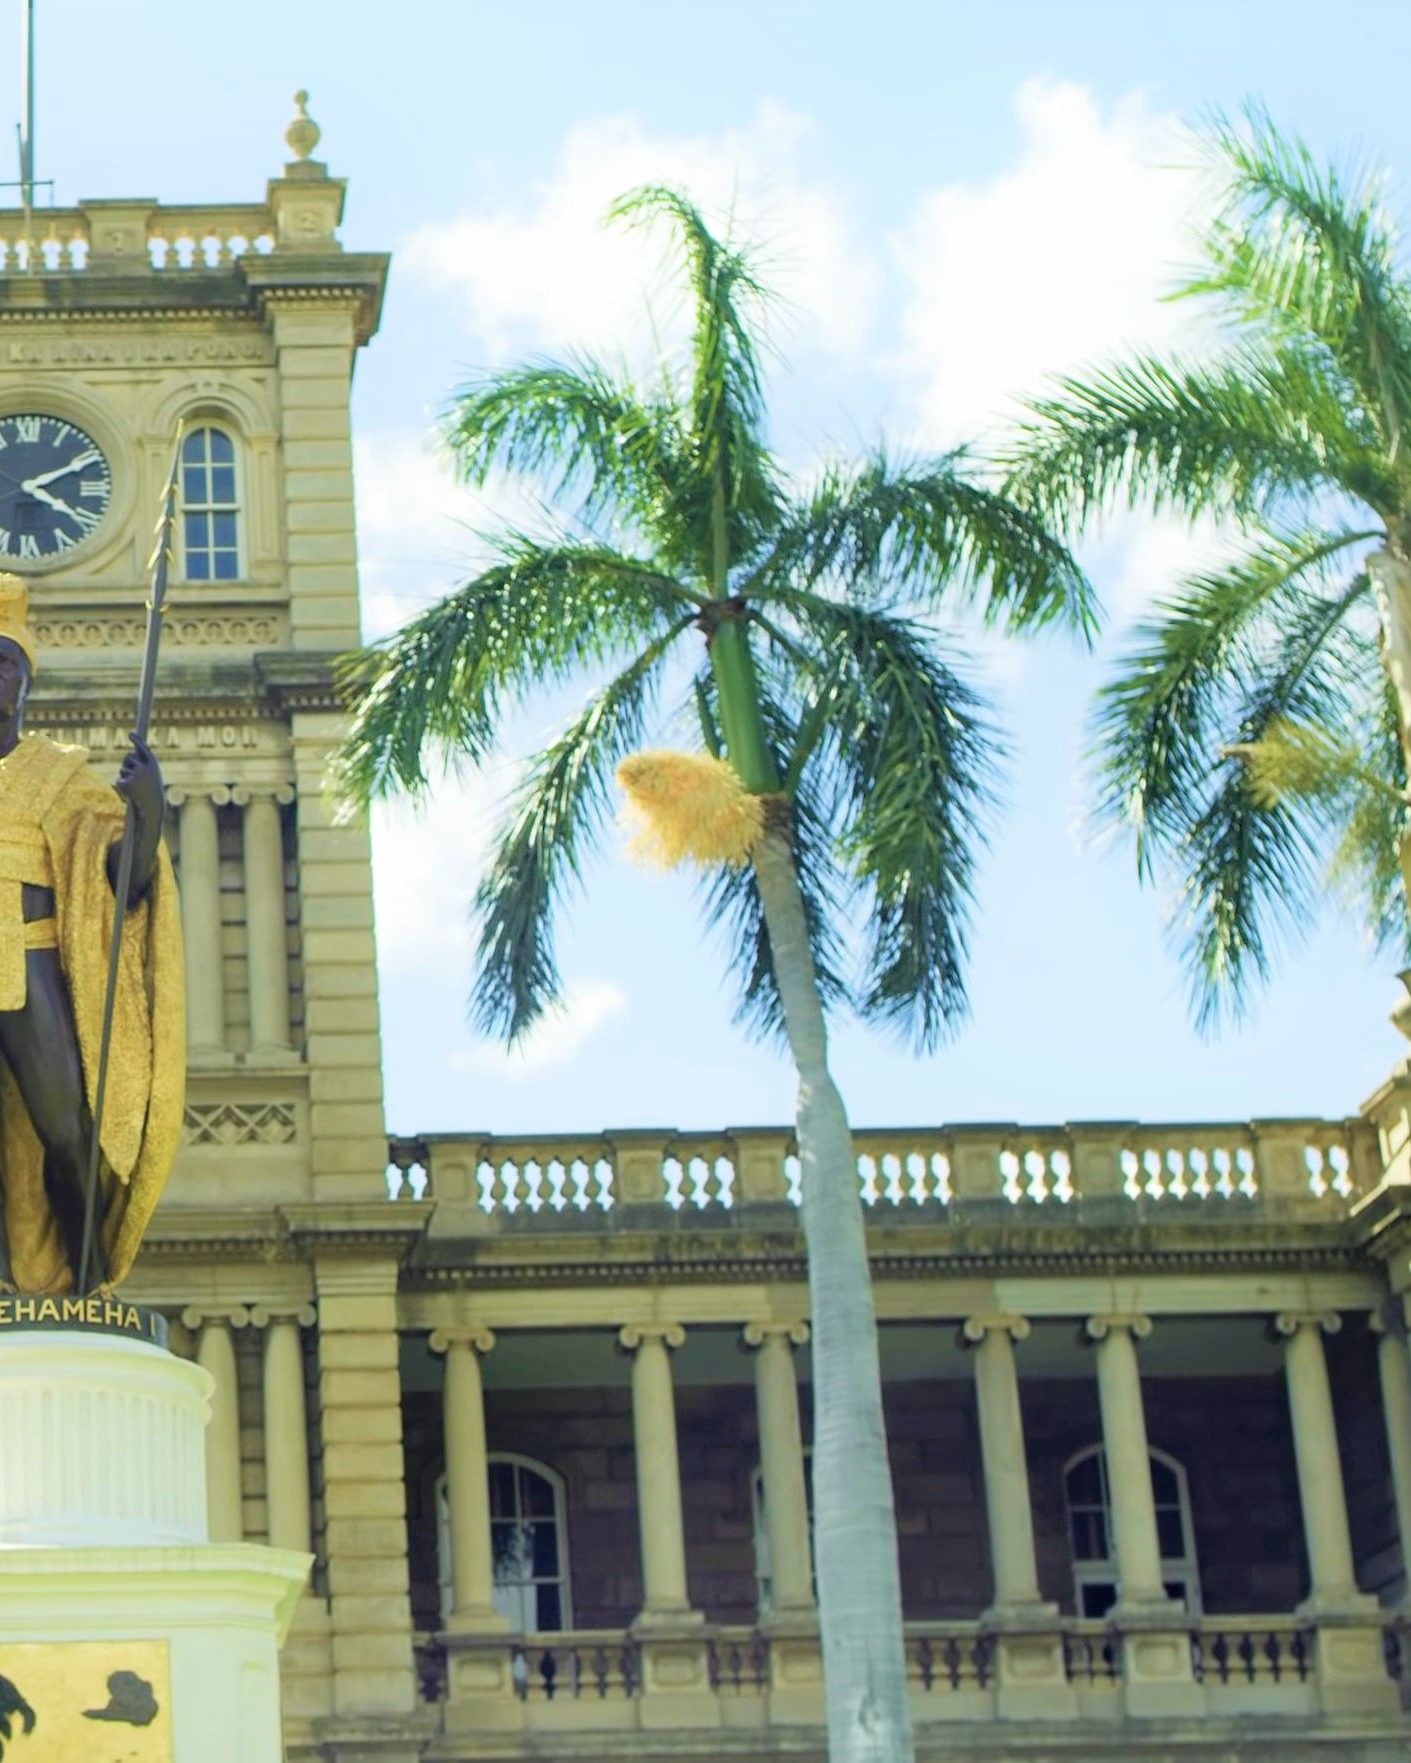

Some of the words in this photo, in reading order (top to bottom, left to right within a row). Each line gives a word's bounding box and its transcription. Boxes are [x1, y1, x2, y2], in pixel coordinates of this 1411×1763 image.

[16, 416, 41, 442] XII
[52, 424, 71, 447] I
[80, 480, 110, 497] III
[150, 1312, 156, 1336] I
